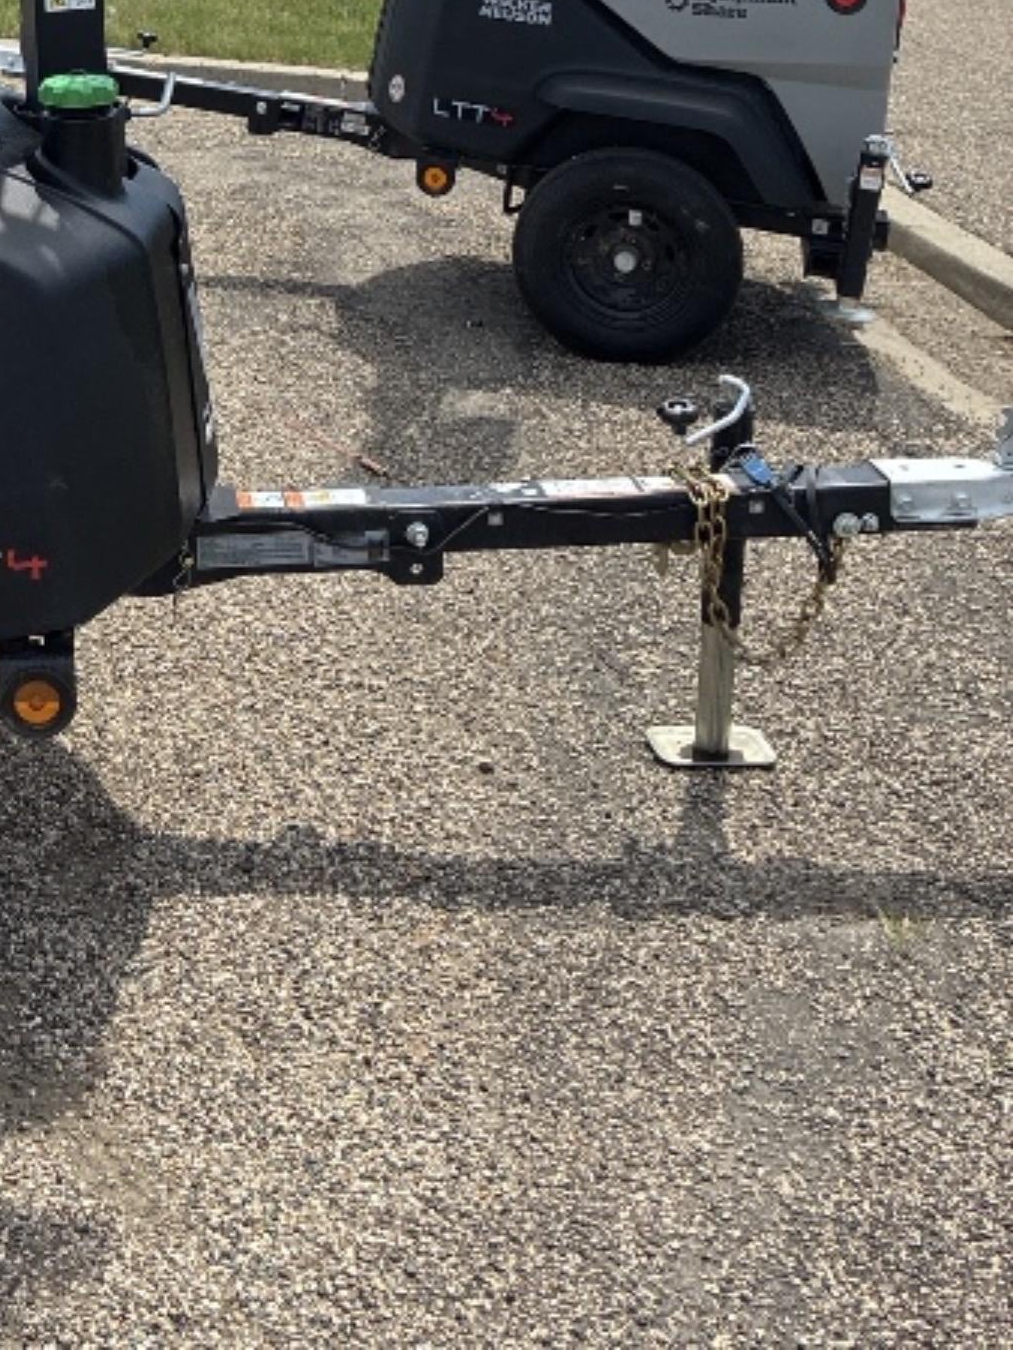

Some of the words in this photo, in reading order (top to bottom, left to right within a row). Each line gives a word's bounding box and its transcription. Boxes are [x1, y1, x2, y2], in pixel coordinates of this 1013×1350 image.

[478, 5, 552, 25] NEUSON
[692, 2, 748, 19] Share
[433, 97, 514, 127] LTT4
